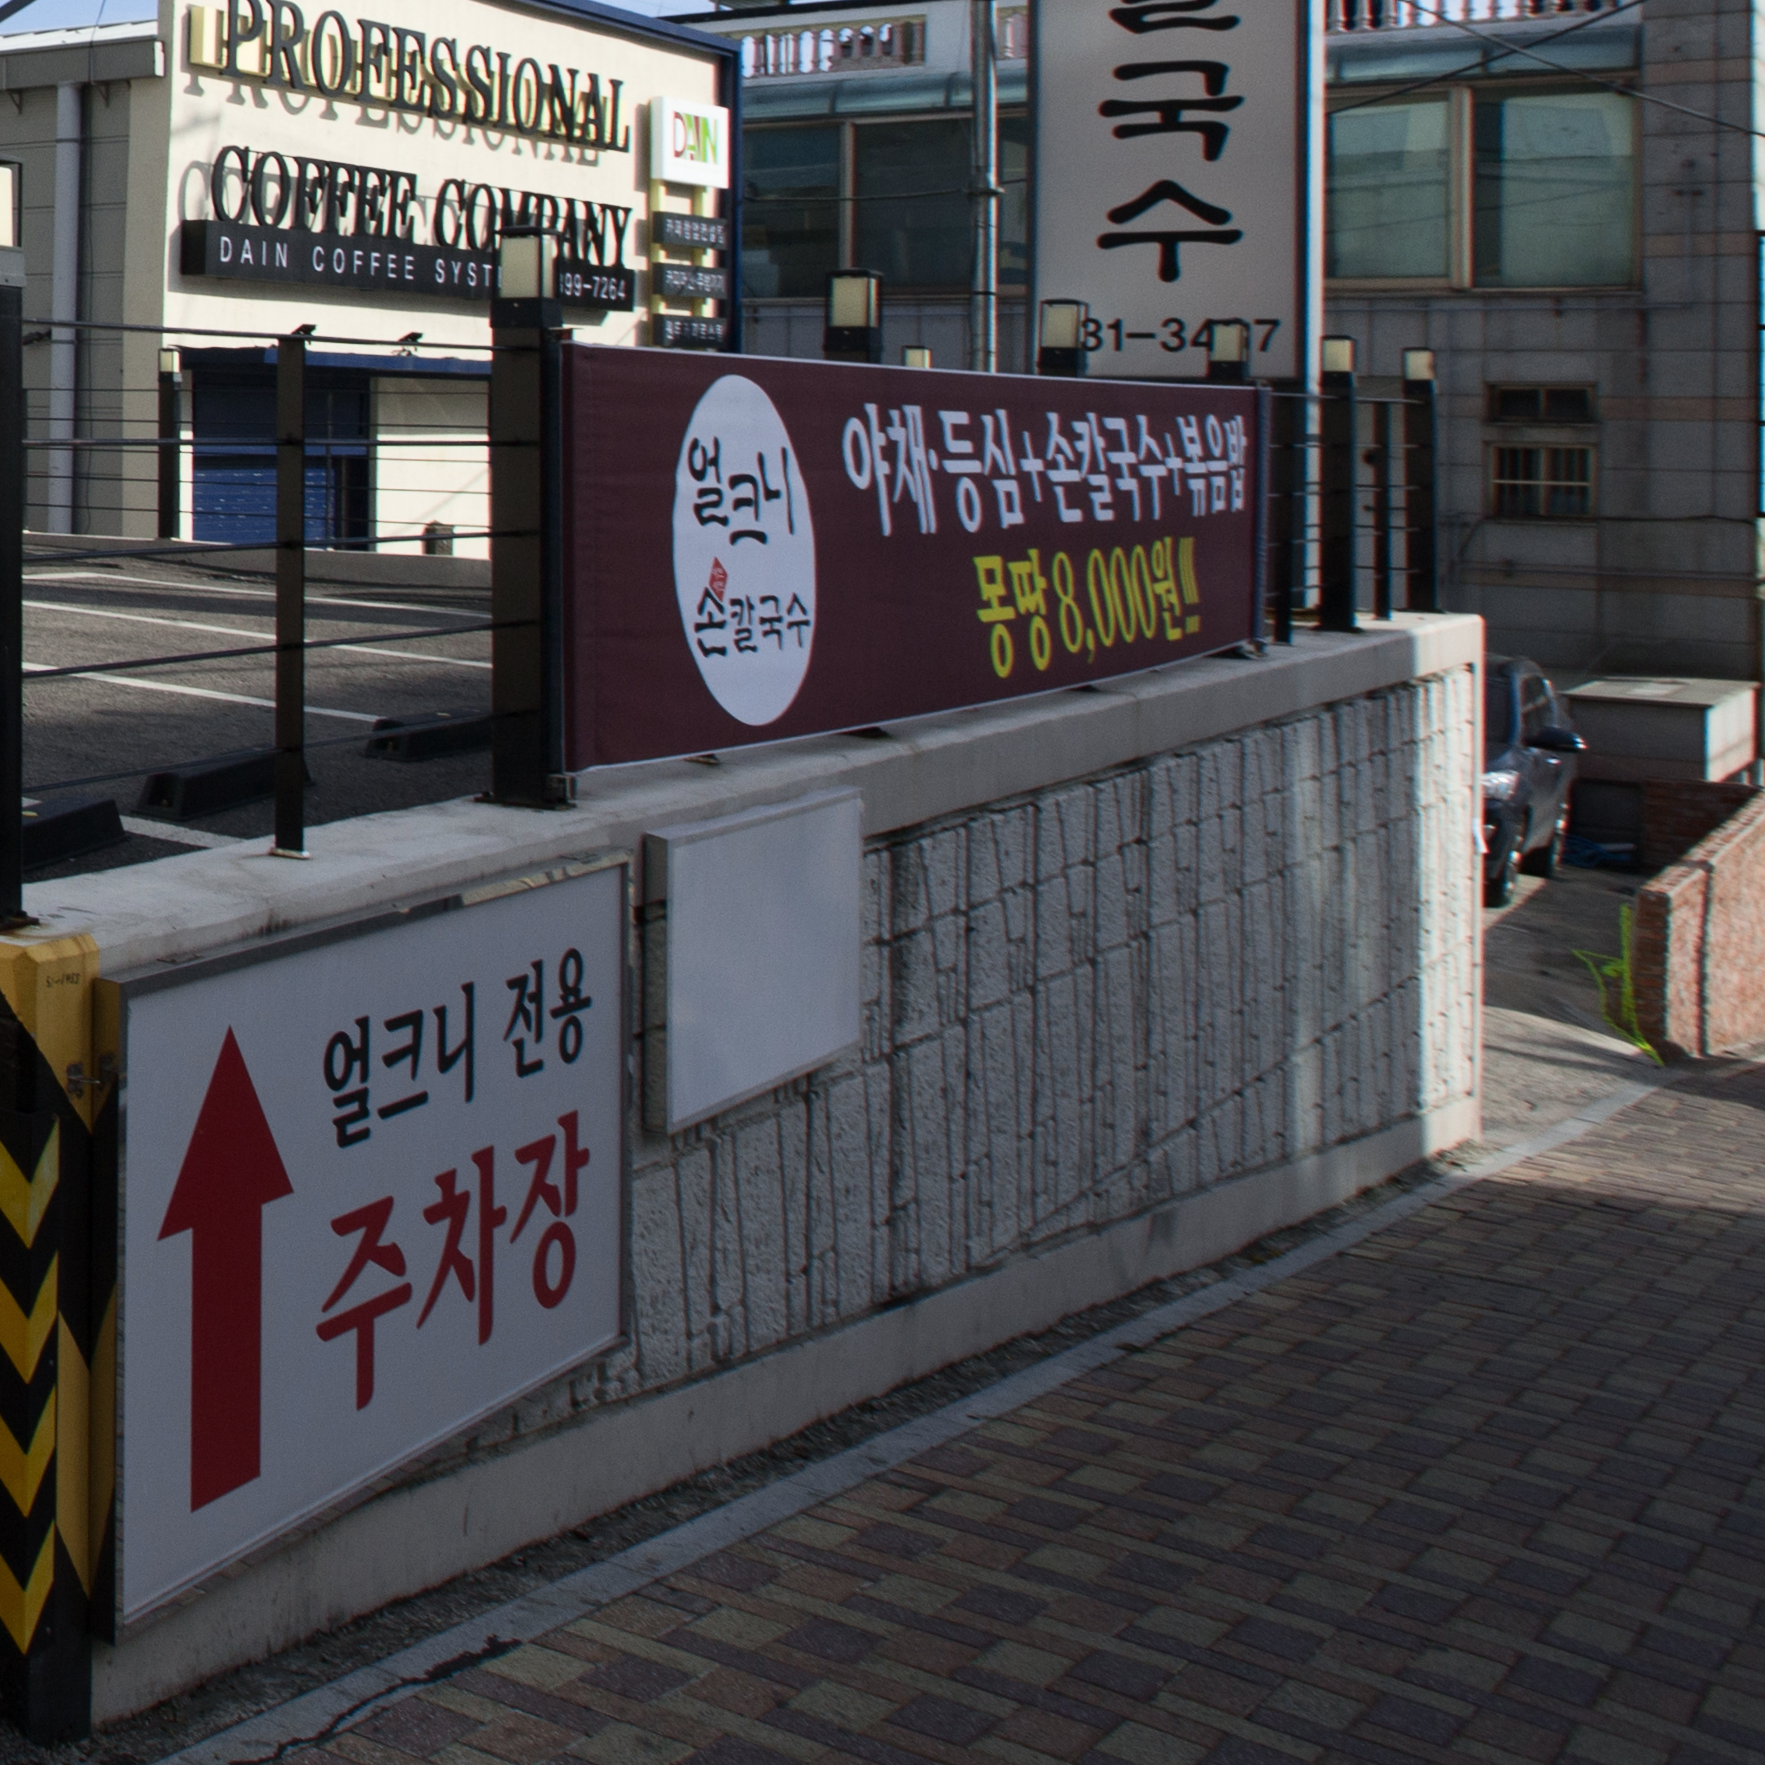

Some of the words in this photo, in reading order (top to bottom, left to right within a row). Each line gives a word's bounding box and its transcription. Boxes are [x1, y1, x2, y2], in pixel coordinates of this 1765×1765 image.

[210, 144, 418, 236] COFFEE
[219, 235, 289, 269] DAIN
[311, 244, 415, 281] COFFEE
[434, 257, 503, 289] SYST
[1047, 316, 1280, 353] 31-347
[687, 435, 795, 547] 얼크니
[693, 586, 811, 659] 손칼국수
[972, 547, 1048, 679] 몽땅
[322, 980, 476, 1149] 얼크니
[502, 947, 593, 1079] 전용
[314, 1108, 591, 1412] 주차장
